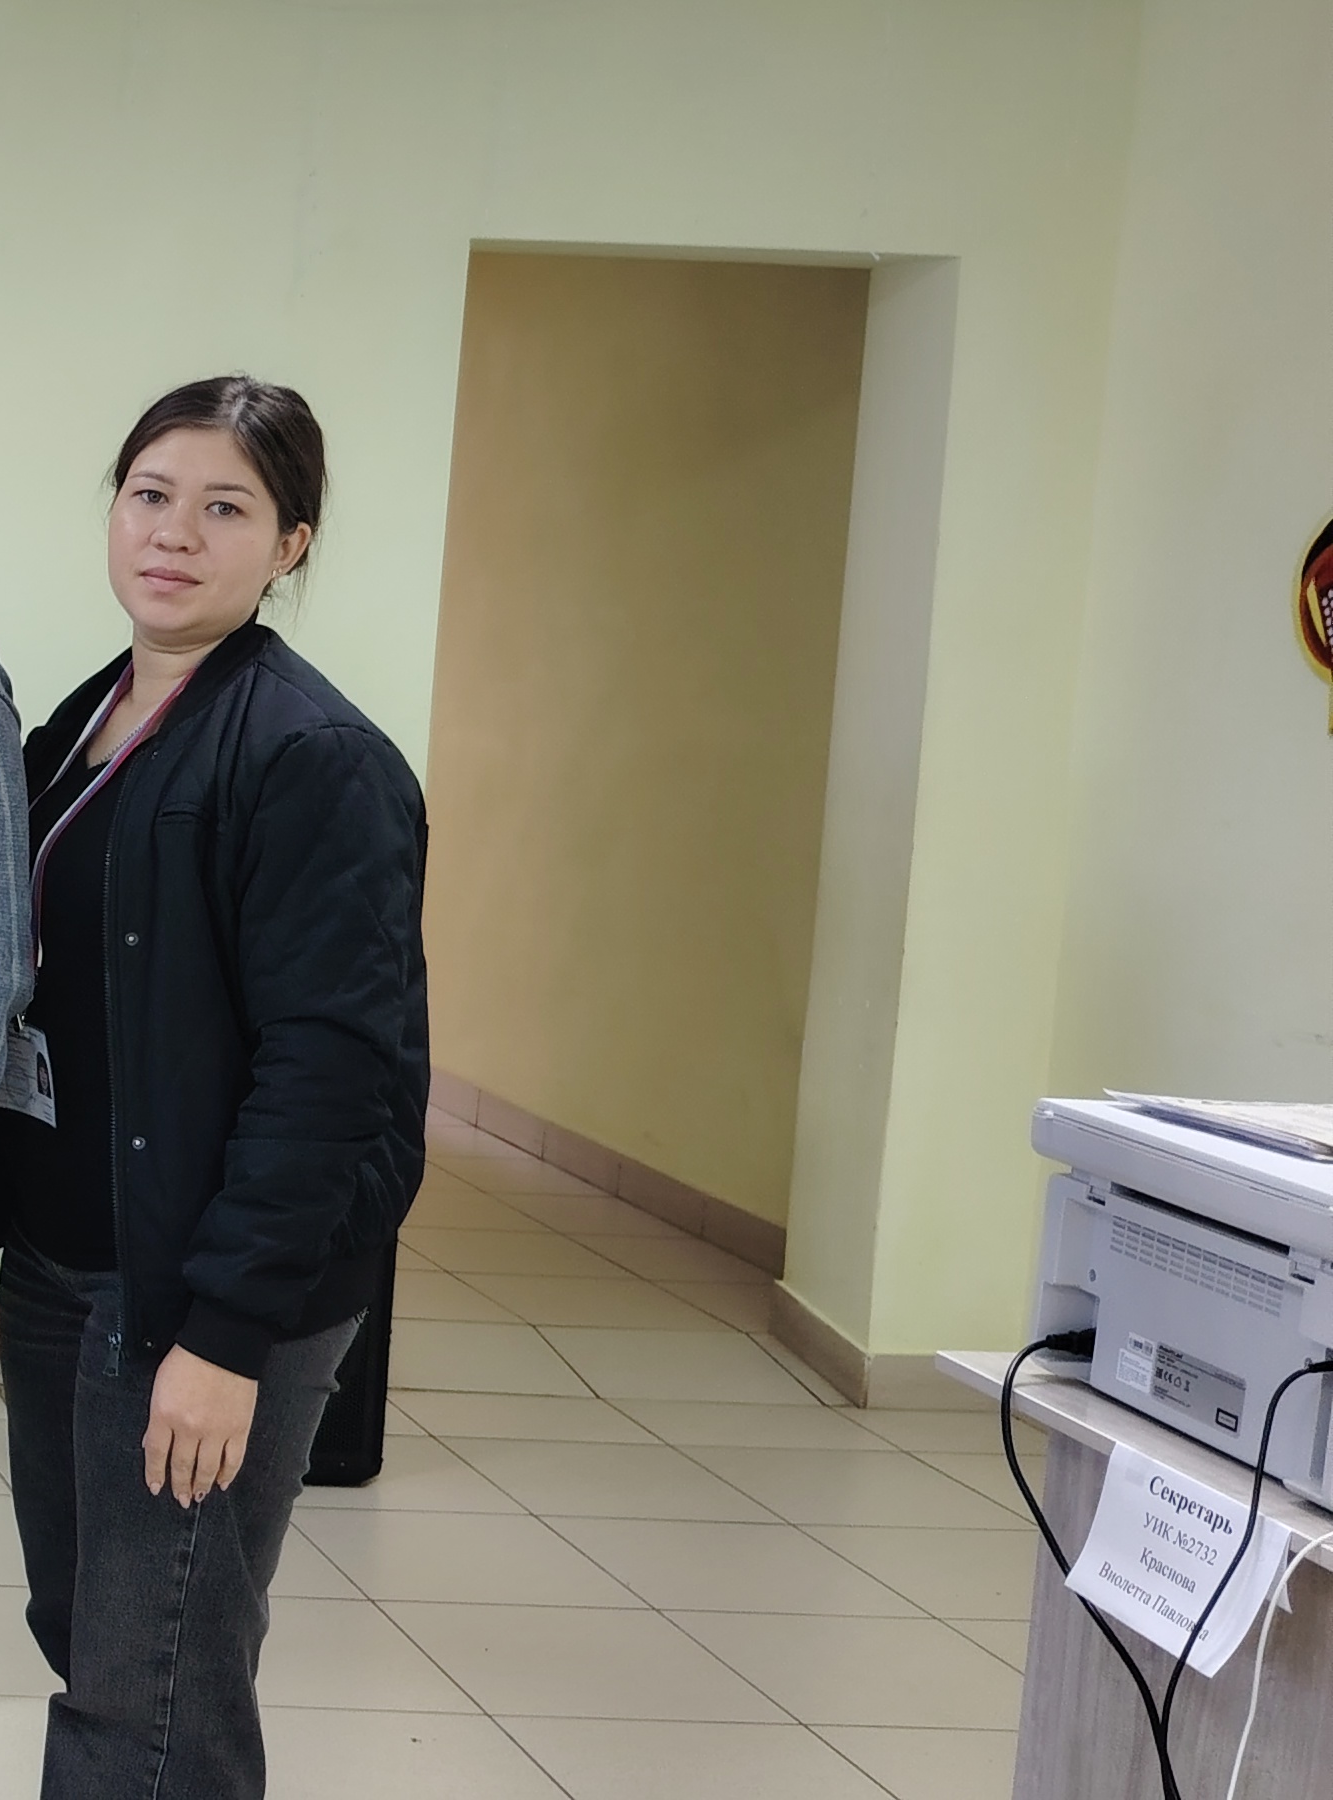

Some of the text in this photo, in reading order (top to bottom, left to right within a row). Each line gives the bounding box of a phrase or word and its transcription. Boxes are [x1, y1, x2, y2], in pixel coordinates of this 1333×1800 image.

[1149, 1476, 1233, 1535] Секретарь
[1143, 1512, 1218, 1566] УИК №2732
[1139, 1547, 1196, 1593] Краснова
[1098, 1561, 1209, 1641] Виолетта Павлова
